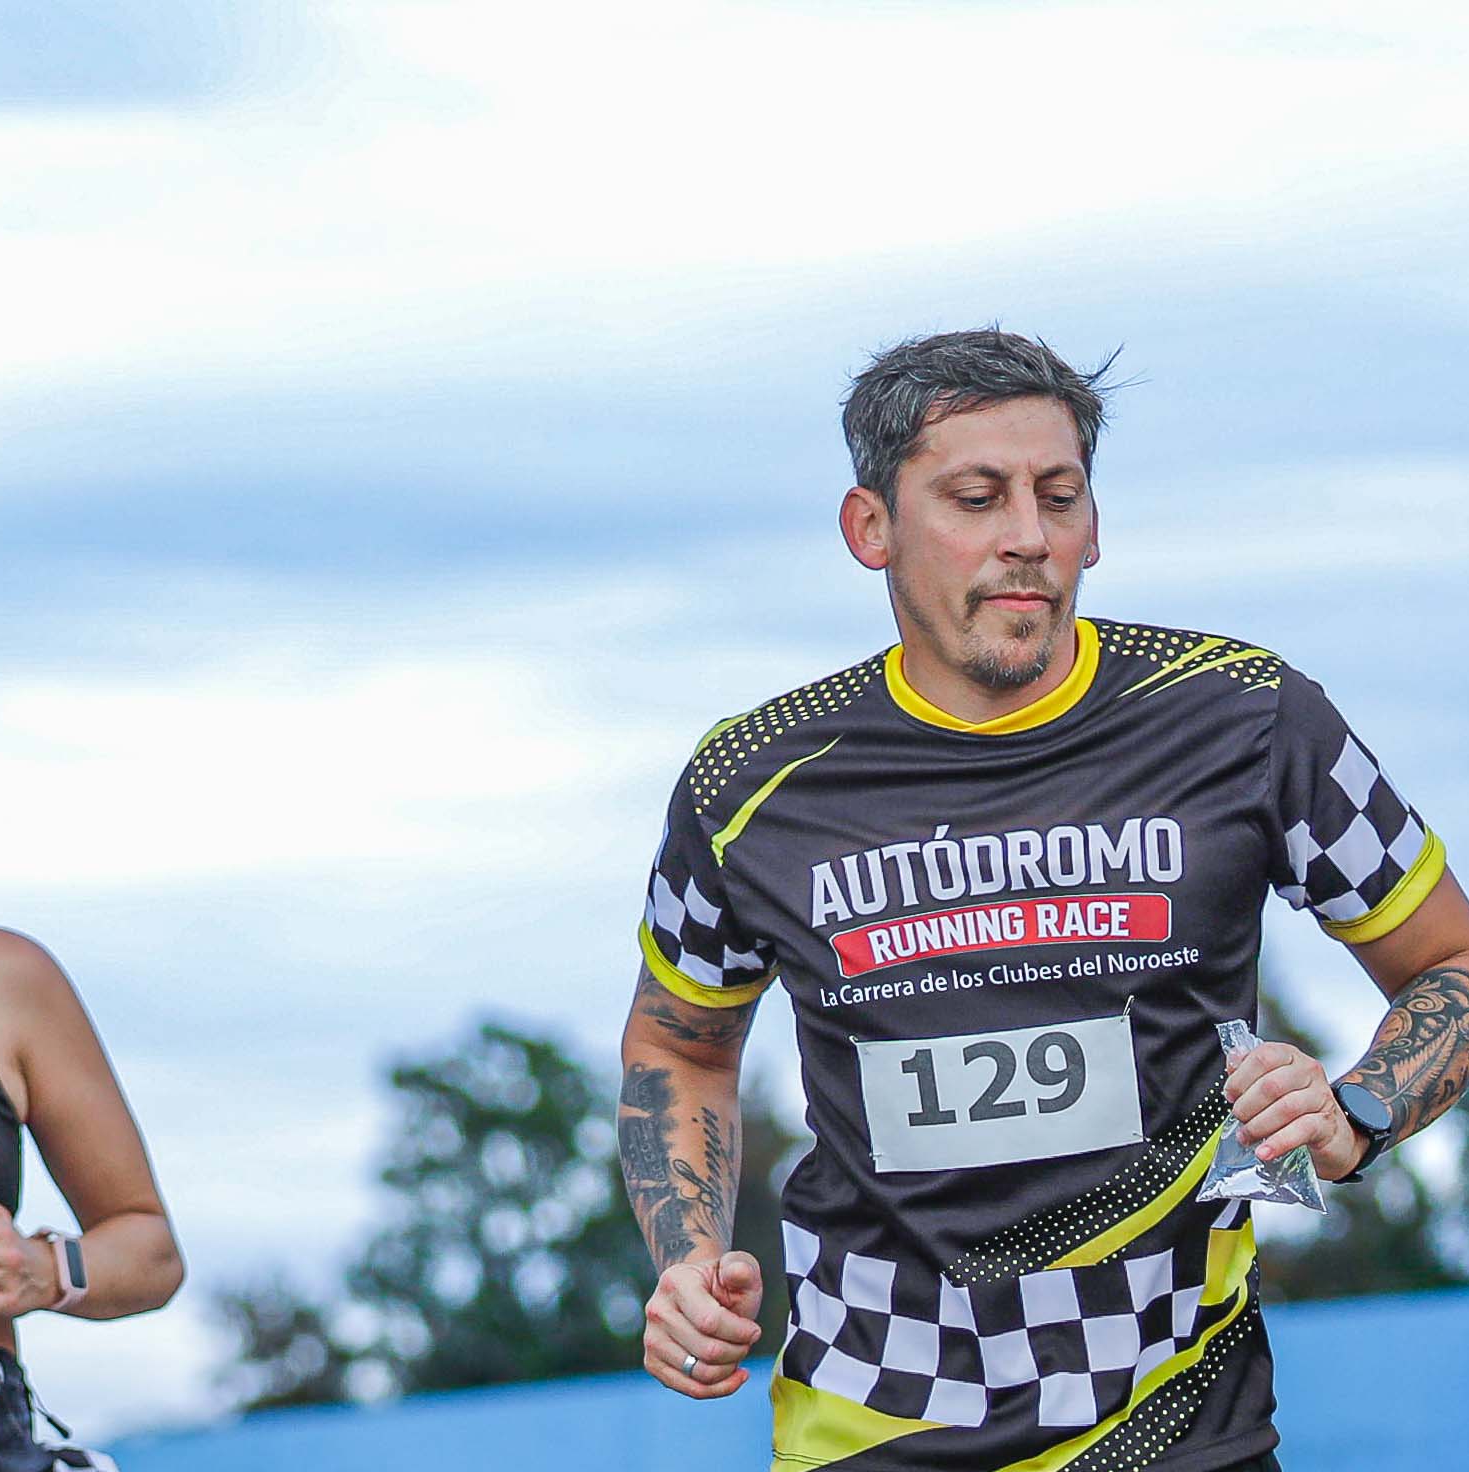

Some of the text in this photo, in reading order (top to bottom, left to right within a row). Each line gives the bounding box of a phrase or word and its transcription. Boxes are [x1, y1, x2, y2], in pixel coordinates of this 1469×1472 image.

[810, 817, 1184, 928] AUTÓDROMO
[866, 901, 1131, 965] RUNNING RACE
[820, 946, 1200, 1008] La Carrera de los Clubes del Noroeste
[900, 1031, 1087, 1127] 129
